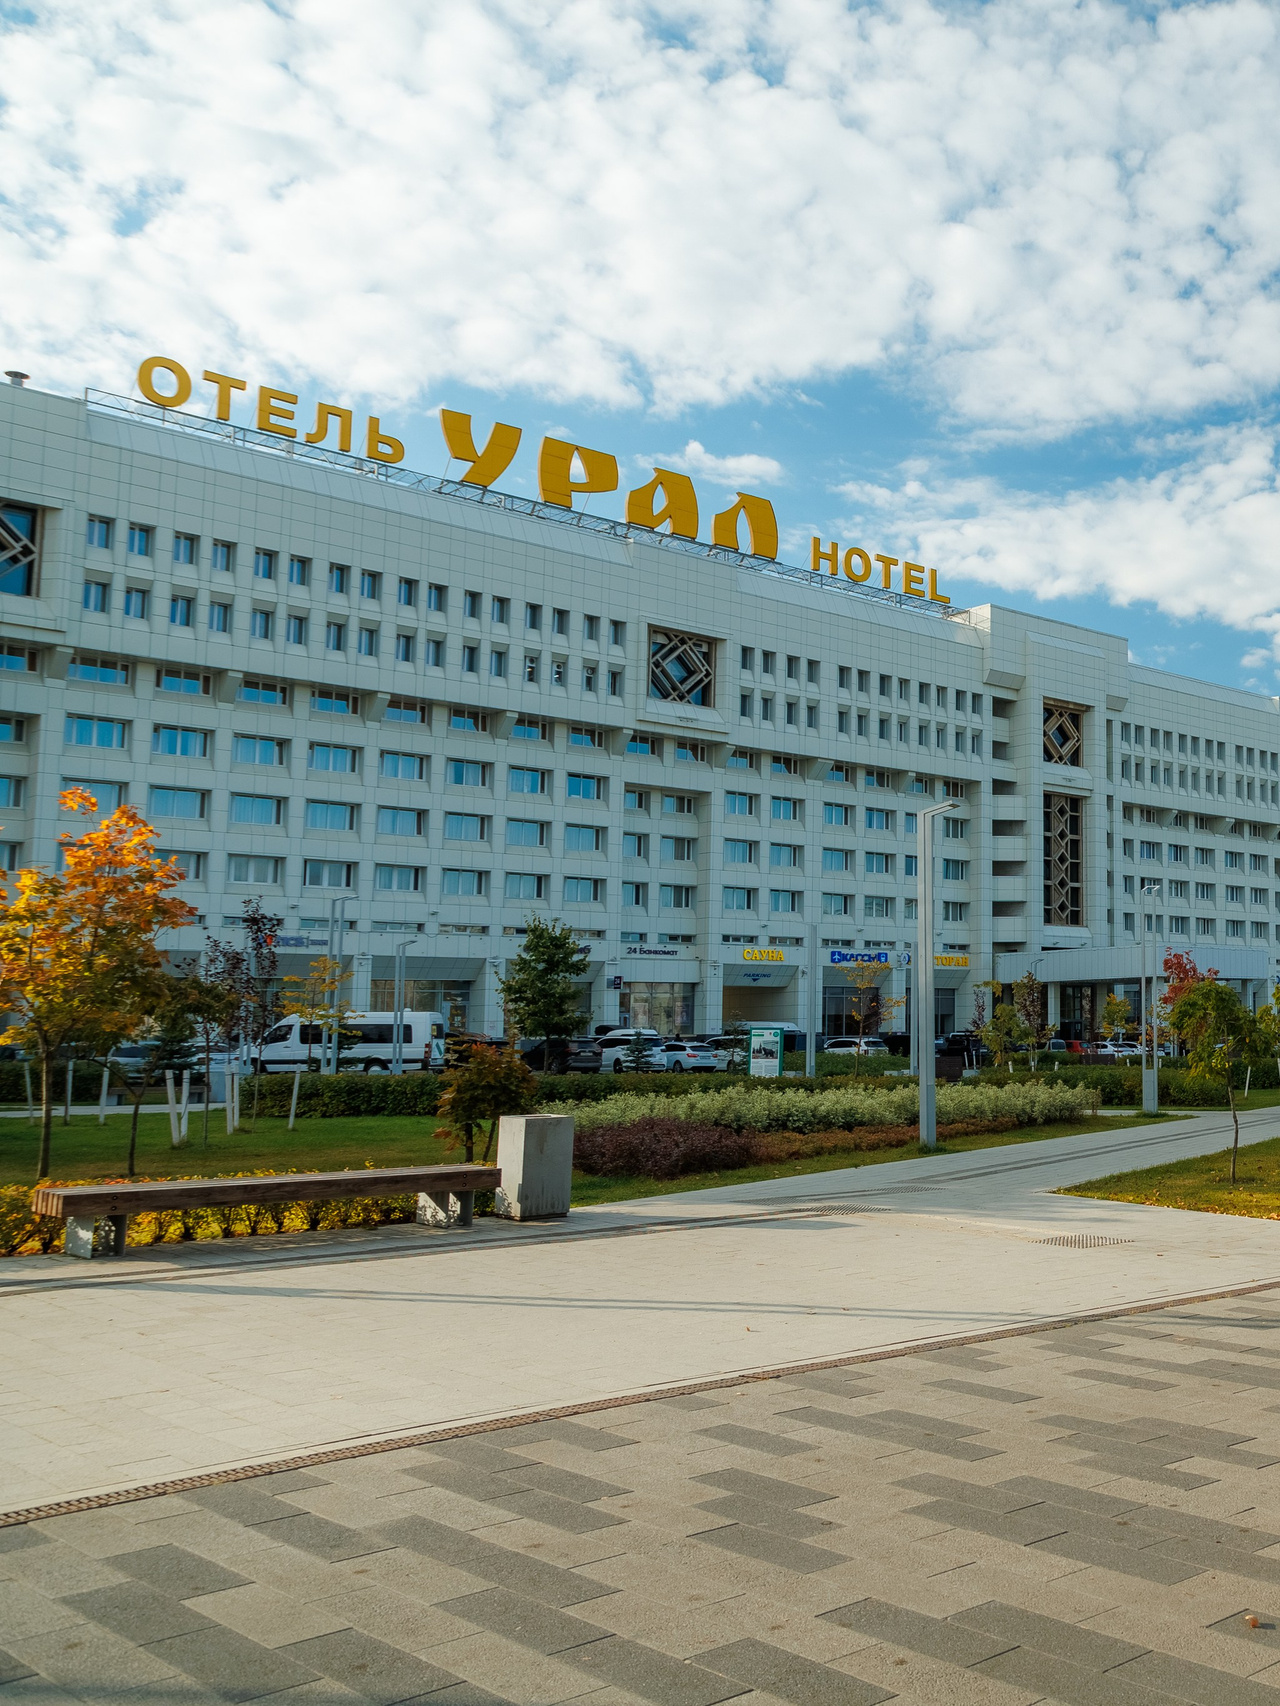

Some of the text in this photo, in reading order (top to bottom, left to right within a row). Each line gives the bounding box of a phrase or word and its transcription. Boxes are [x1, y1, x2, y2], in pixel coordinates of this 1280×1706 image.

[137, 355, 950, 604] ОТЕЛЬ УРАЛ HOTEL
[639, 947, 678, 956] Банкомат
[743, 949, 784, 961] САУНА
